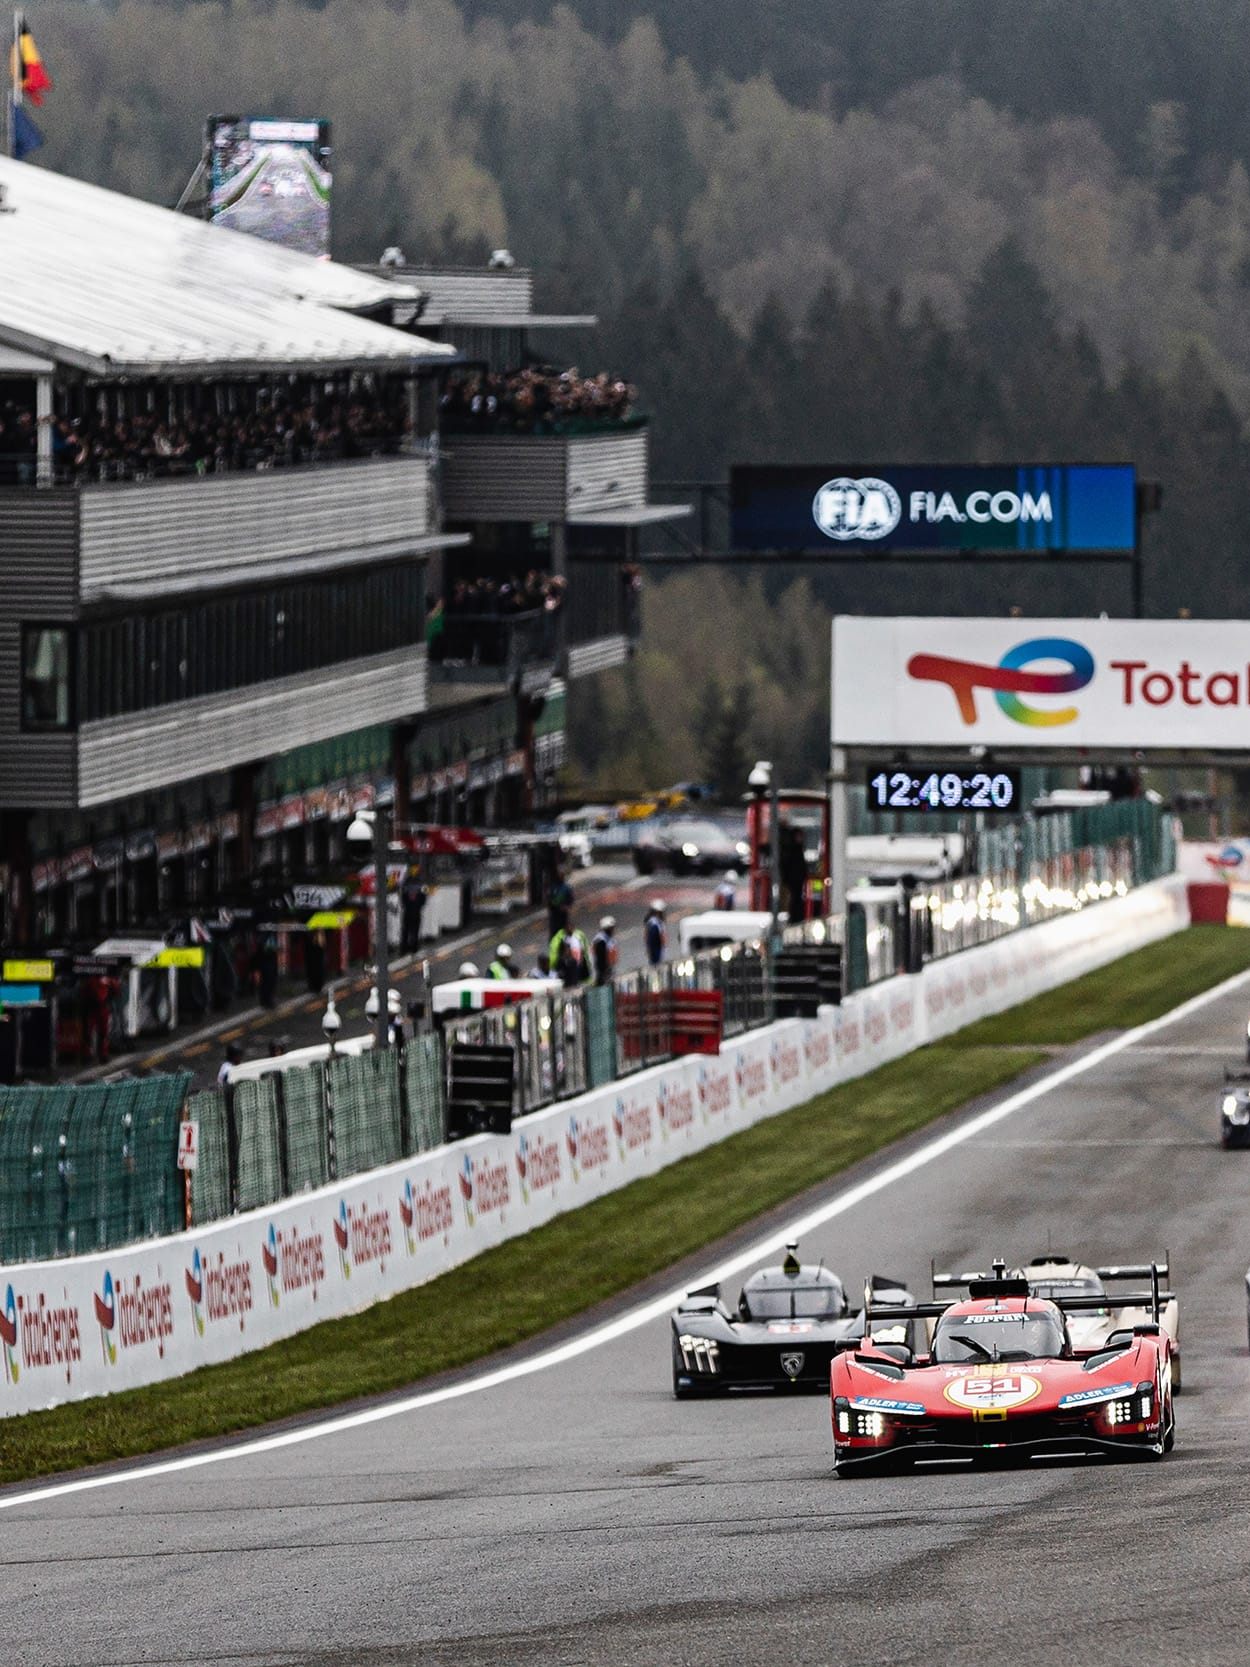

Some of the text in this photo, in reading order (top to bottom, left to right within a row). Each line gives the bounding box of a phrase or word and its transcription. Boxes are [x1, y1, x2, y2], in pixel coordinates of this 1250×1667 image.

[819, 489, 891, 526] FIA
[909, 490, 1053, 523] FIA.COM
[871, 772, 1014, 808] 12:49:20
[963, 1312, 1030, 1325] Ferrari
[17, 1286, 82, 1385] TotalEnergies
[965, 1378, 1020, 1394] 51
[1066, 1389, 1104, 1403] ADLER
[858, 1398, 898, 1408] ADLER
